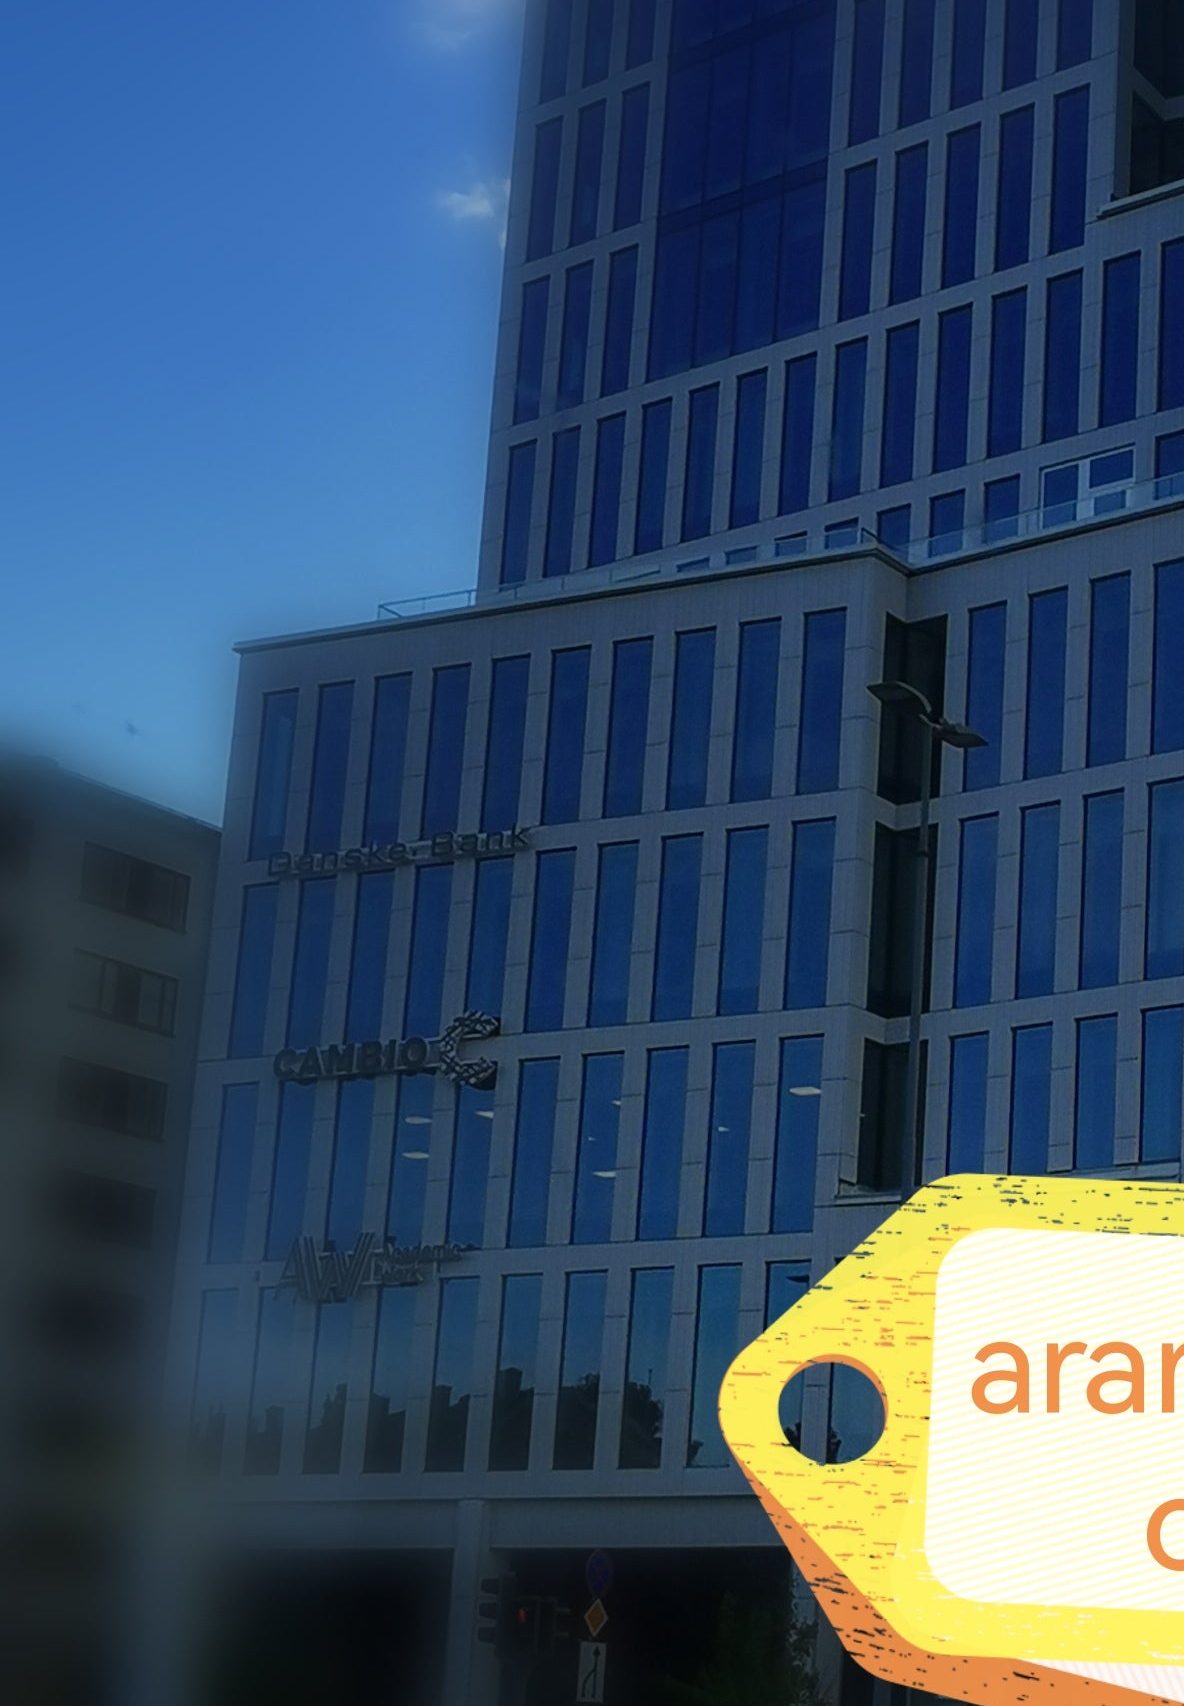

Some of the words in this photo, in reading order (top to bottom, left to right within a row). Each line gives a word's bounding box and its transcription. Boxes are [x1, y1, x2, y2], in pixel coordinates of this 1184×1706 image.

[268, 841, 408, 877] Danske
[431, 822, 534, 857] Bank
[273, 1036, 429, 1081] CAMBIO
